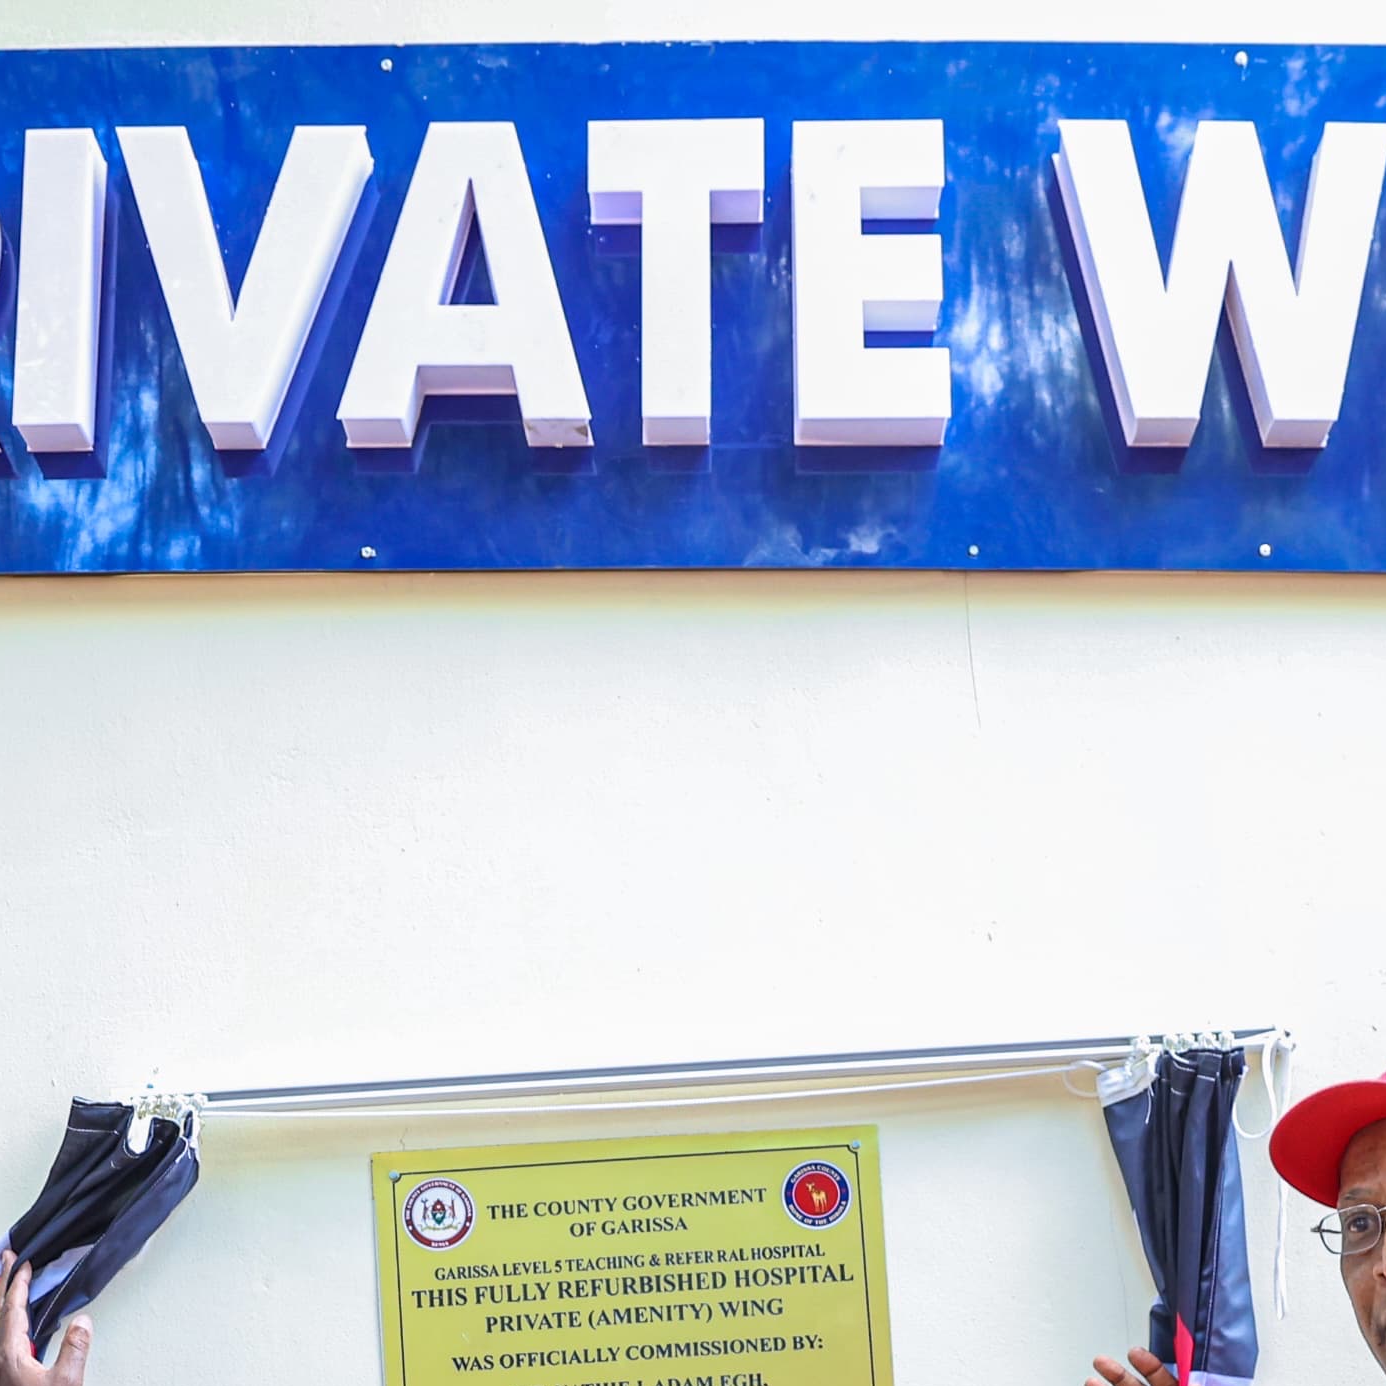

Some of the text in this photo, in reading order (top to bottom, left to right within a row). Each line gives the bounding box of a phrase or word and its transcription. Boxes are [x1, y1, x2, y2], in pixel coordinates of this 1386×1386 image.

[486, 1188, 767, 1220] THE COUNTY GOVERNMENT
[569, 1216, 688, 1237] OF GARISSA
[434, 1264, 500, 1281] GARISSA
[502, 1260, 552, 1277] LEVEL
[554, 1259, 562, 1273] 5
[564, 1254, 645, 1272] TEACHING
[649, 1254, 661, 1267] &
[751, 1243, 826, 1261] HOSPITAL
[411, 1263, 854, 1309] THIS FULLY REFURBISHED HOSPITAL
[485, 1298, 783, 1334] PRIVATE (AMENITY) WING
[451, 1334, 823, 1372] WAS OFFICIALLY COMMISSIONED BY:
